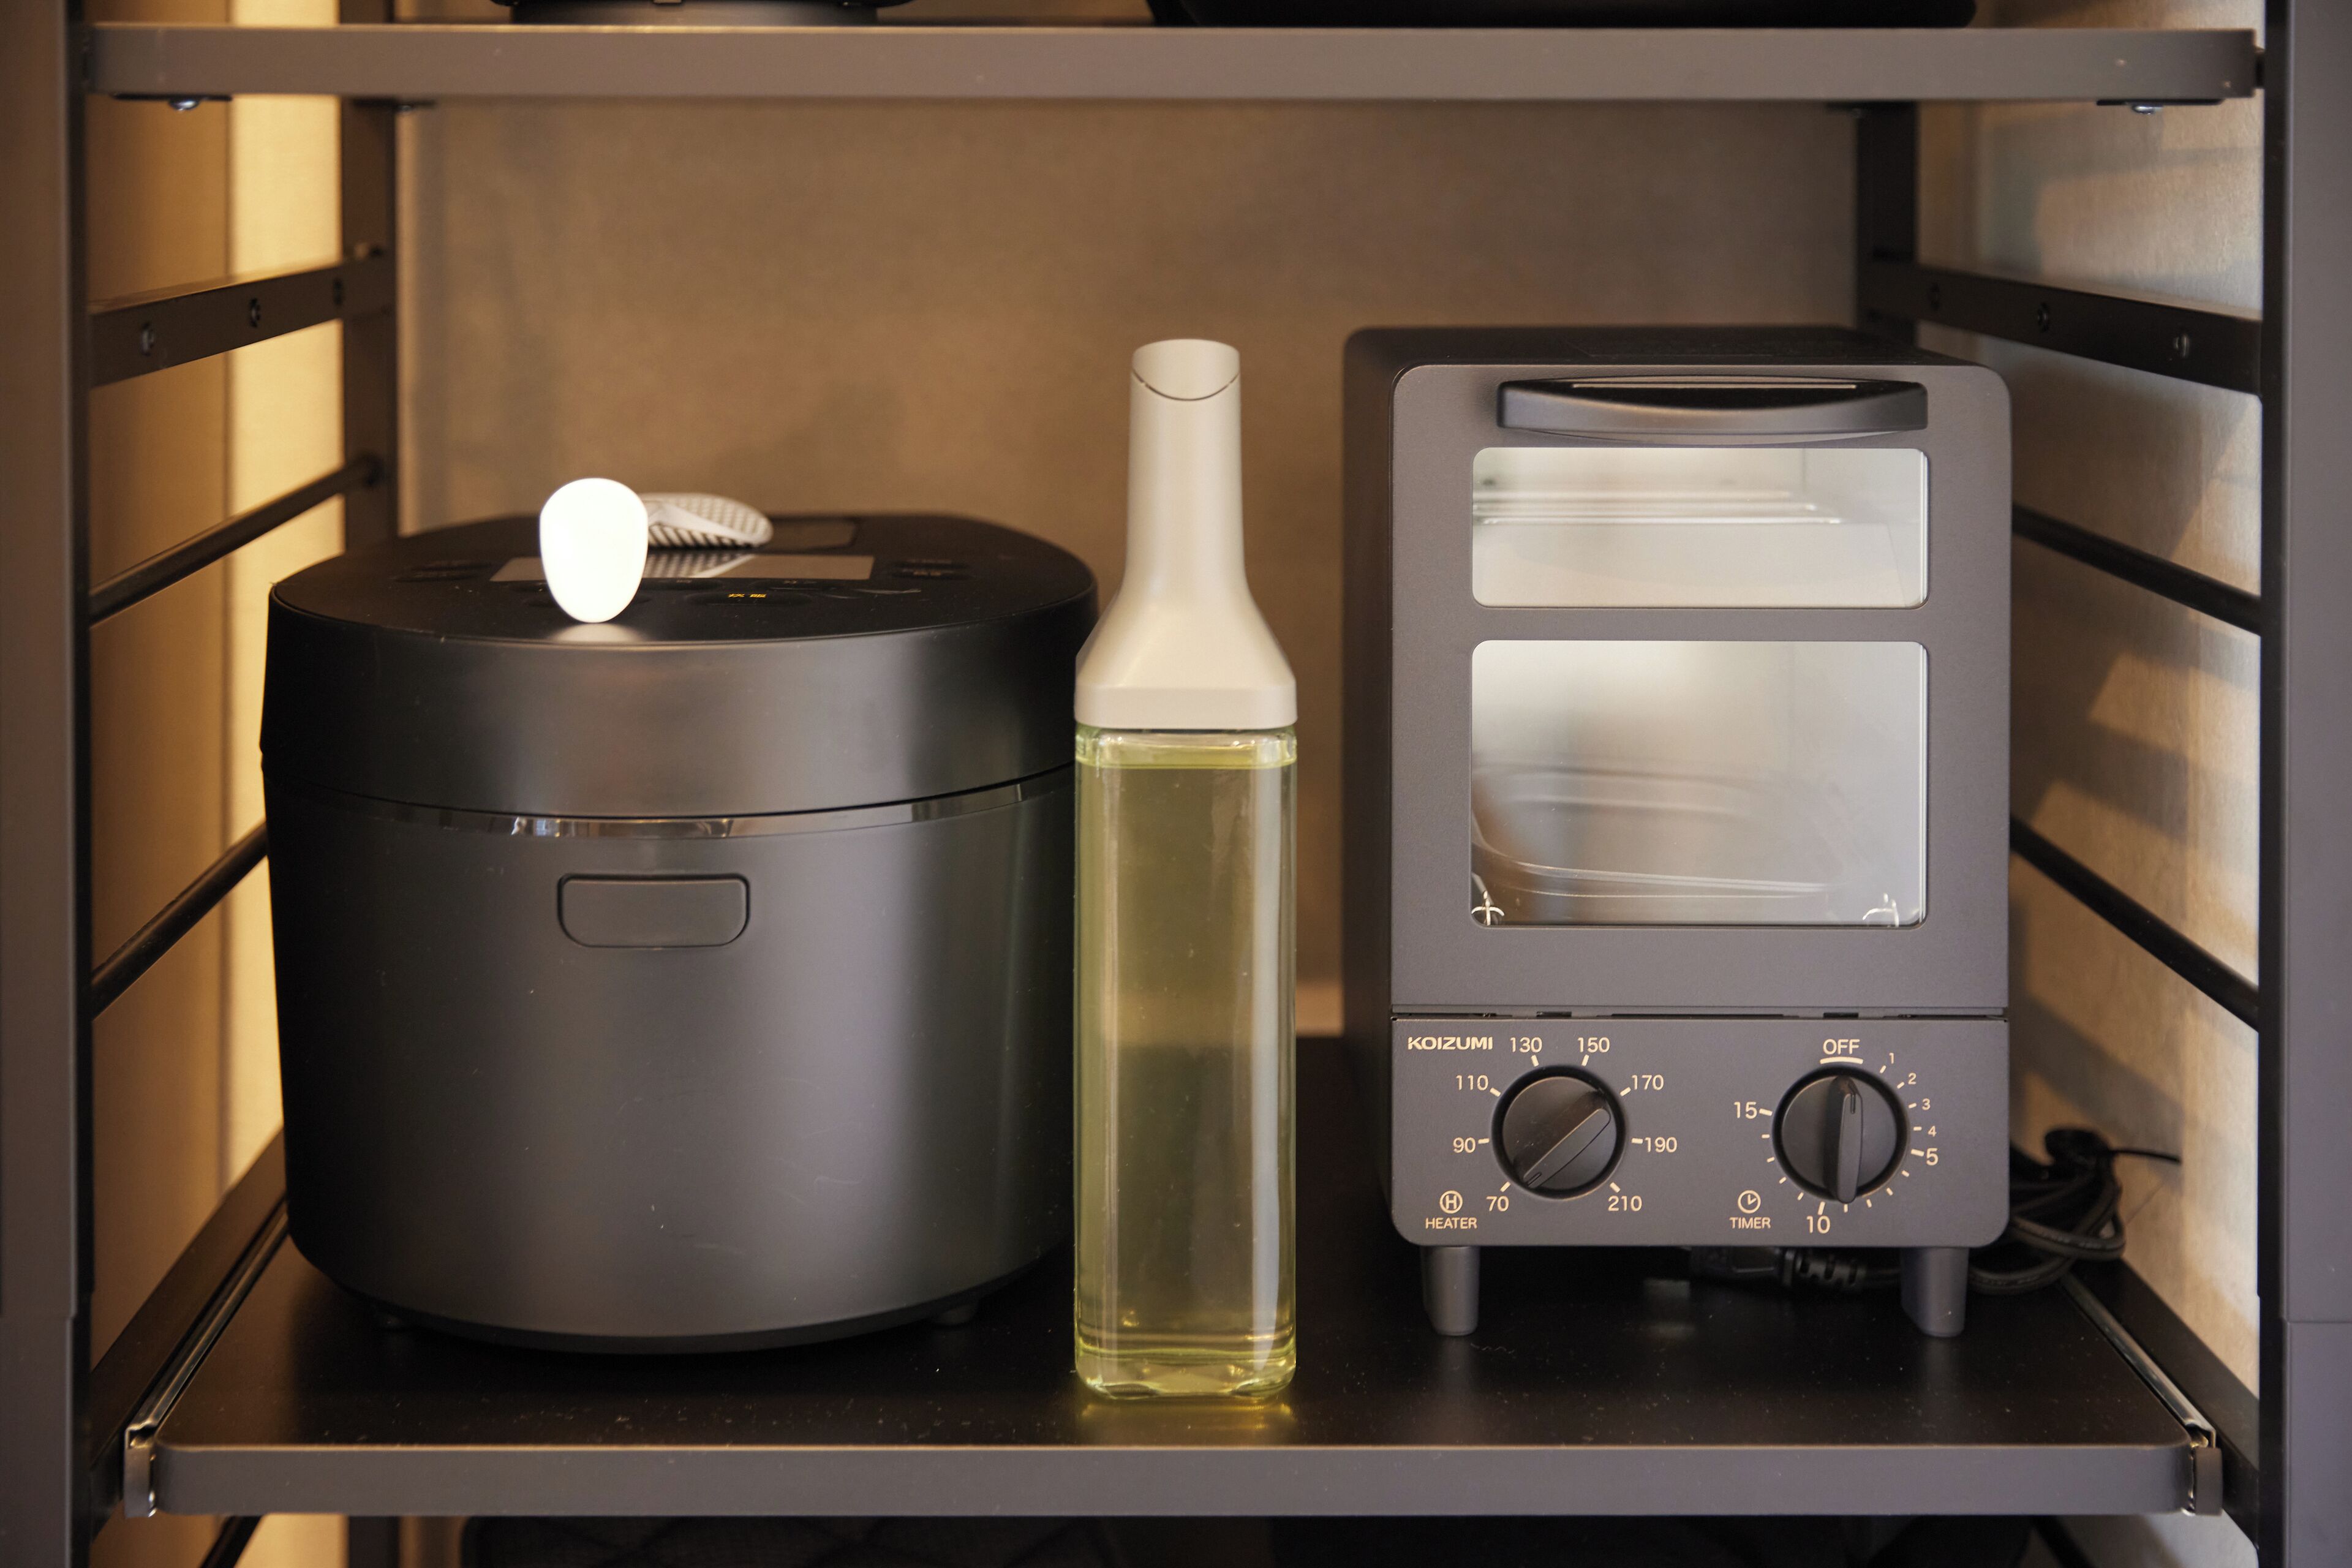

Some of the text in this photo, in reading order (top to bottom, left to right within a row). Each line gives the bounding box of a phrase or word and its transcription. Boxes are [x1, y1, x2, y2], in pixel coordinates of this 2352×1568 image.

[1408, 1037, 1493, 1049] KOIZUMI
[1510, 1038, 1542, 1052] 130
[1578, 1038, 1610, 1052] 150
[1823, 1039, 1860, 1054] OFF
[1890, 1053, 1894, 1063] 1
[1457, 1075, 1488, 1090] 110
[1632, 1075, 1664, 1090] 170
[1909, 1073, 1916, 1084] 2
[1734, 1102, 1757, 1118] 15
[1922, 1098, 1930, 1110] 3
[1928, 1126, 1936, 1136] 4
[1453, 1137, 1476, 1153] 90
[1645, 1137, 1677, 1152] 190
[1927, 1148, 1938, 1166] 5
[1487, 1196, 1509, 1211] 70
[1608, 1196, 1642, 1211] 210
[1426, 1218, 1477, 1229] HEATER
[1730, 1217, 1771, 1229] TIMER
[1807, 1216, 1830, 1234] 10
